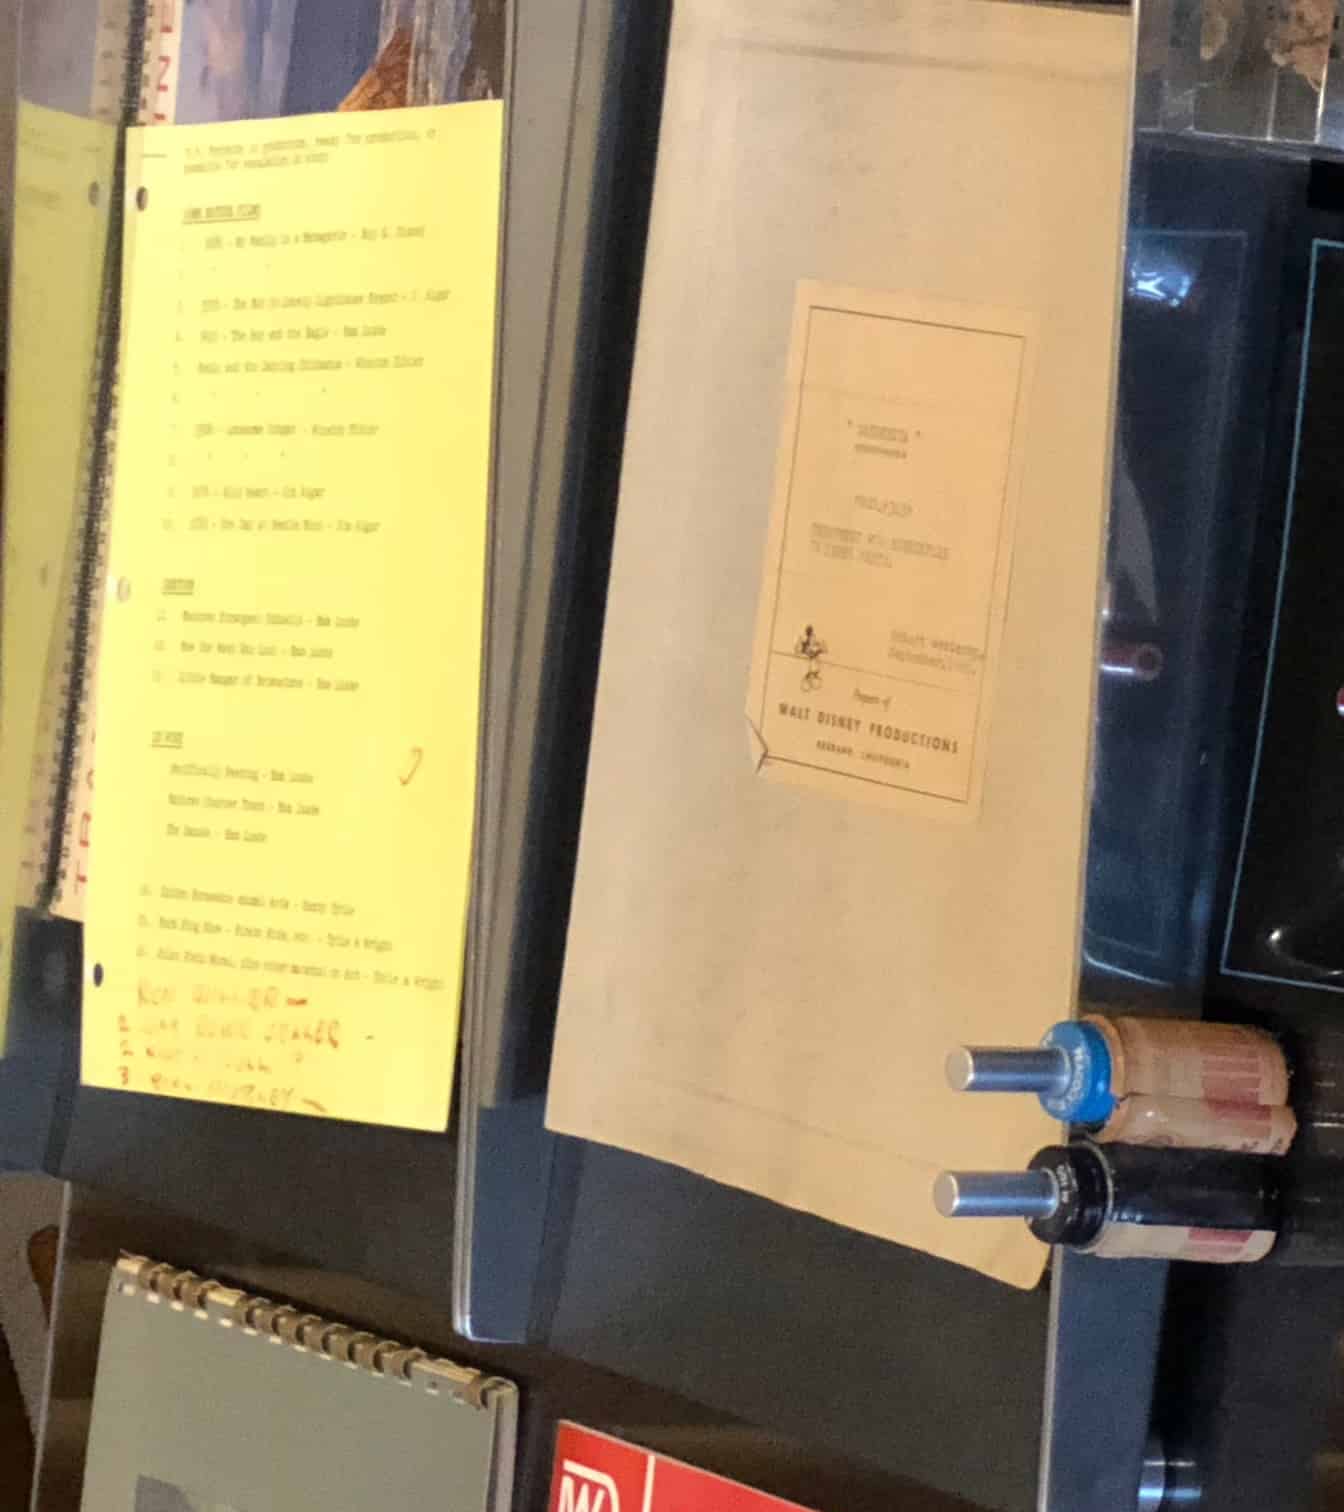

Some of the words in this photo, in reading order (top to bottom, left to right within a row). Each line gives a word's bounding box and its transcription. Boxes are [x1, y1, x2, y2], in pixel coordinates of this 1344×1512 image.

[778, 702, 811, 721] WALT
[816, 711, 862, 732] DISNEY
[869, 722, 960, 755] PRODUCTIONS
